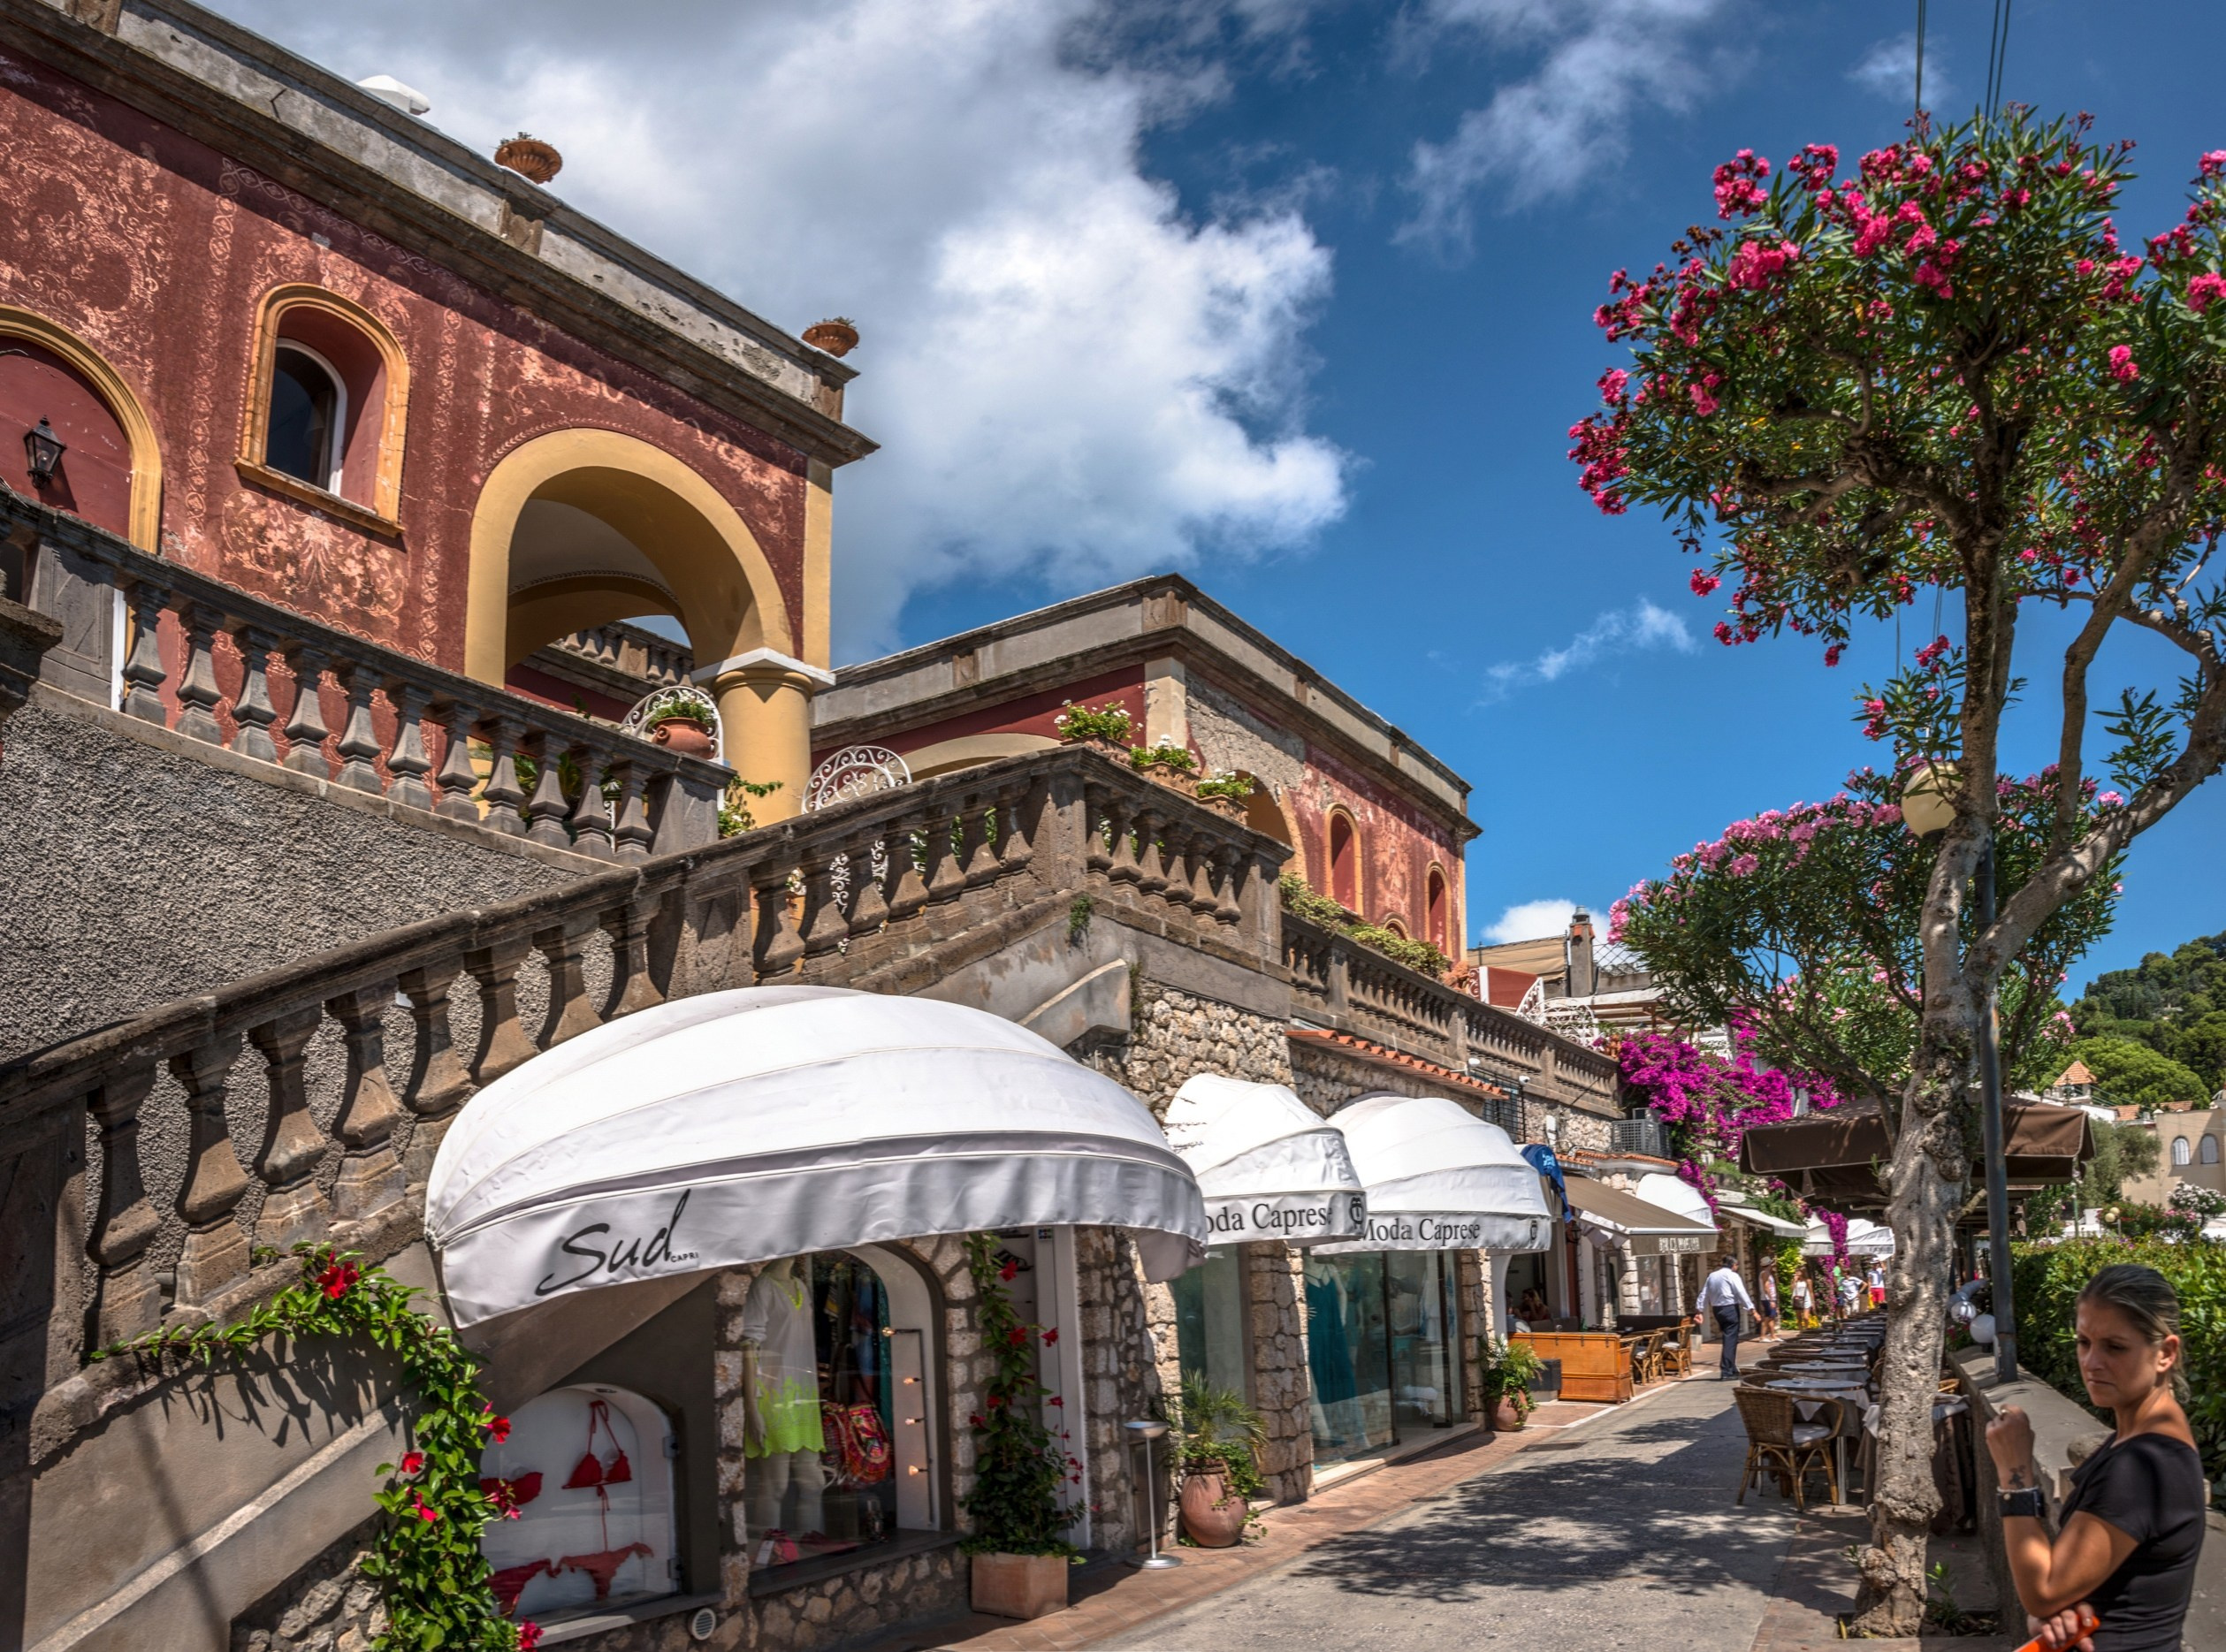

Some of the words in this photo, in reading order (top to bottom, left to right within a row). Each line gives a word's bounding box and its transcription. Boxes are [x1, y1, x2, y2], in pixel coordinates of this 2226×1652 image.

[1205, 1206, 1245, 1234] oda
[1419, 1218, 1482, 1247] Caprese
[535, 1188, 691, 1297] Sud
[670, 1251, 699, 1263] CAPRI
